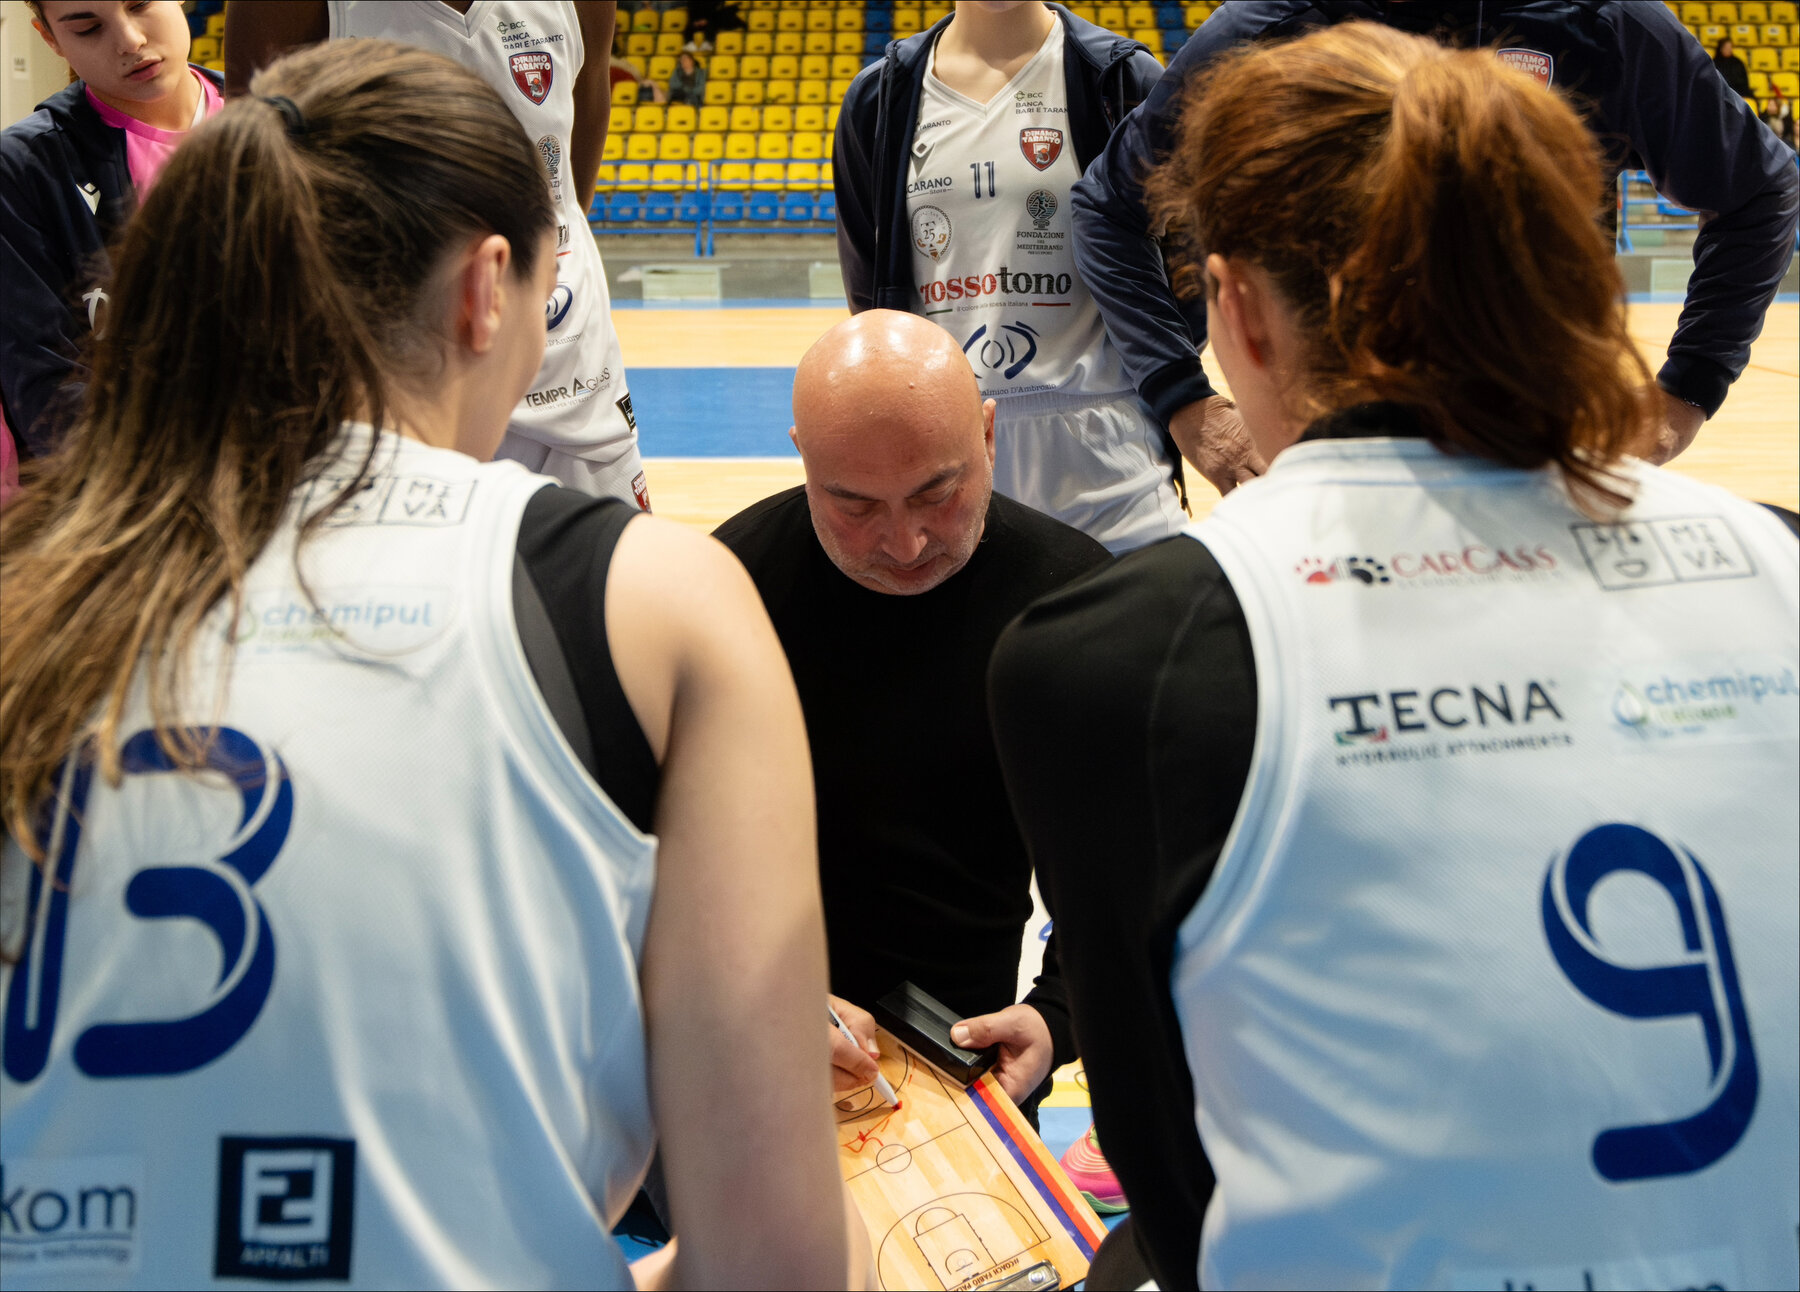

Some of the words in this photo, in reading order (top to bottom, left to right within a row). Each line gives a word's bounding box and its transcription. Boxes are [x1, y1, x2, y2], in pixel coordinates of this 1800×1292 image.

[509, 21, 527, 30] BCC
[501, 32, 530, 42] BANCA
[524, 40, 530, 48] E
[513, 55, 547, 65] DINAMO
[1503, 53, 1545, 66] DINAMO
[512, 62, 551, 72] TARANTO
[1504, 61, 1548, 76] ARANTO
[1015, 100, 1044, 108] BANCA
[1024, 129, 1059, 138] DINAMO
[1022, 136, 1061, 145] TARANTO
[969, 160, 996, 200] 11
[923, 228, 936, 241] 25
[1016, 230, 1065, 239] FONDAZIONE
[980, 387, 1009, 397] almico
[1329, 679, 1564, 736] TECNA
[1541, 823, 1760, 1182] 9
